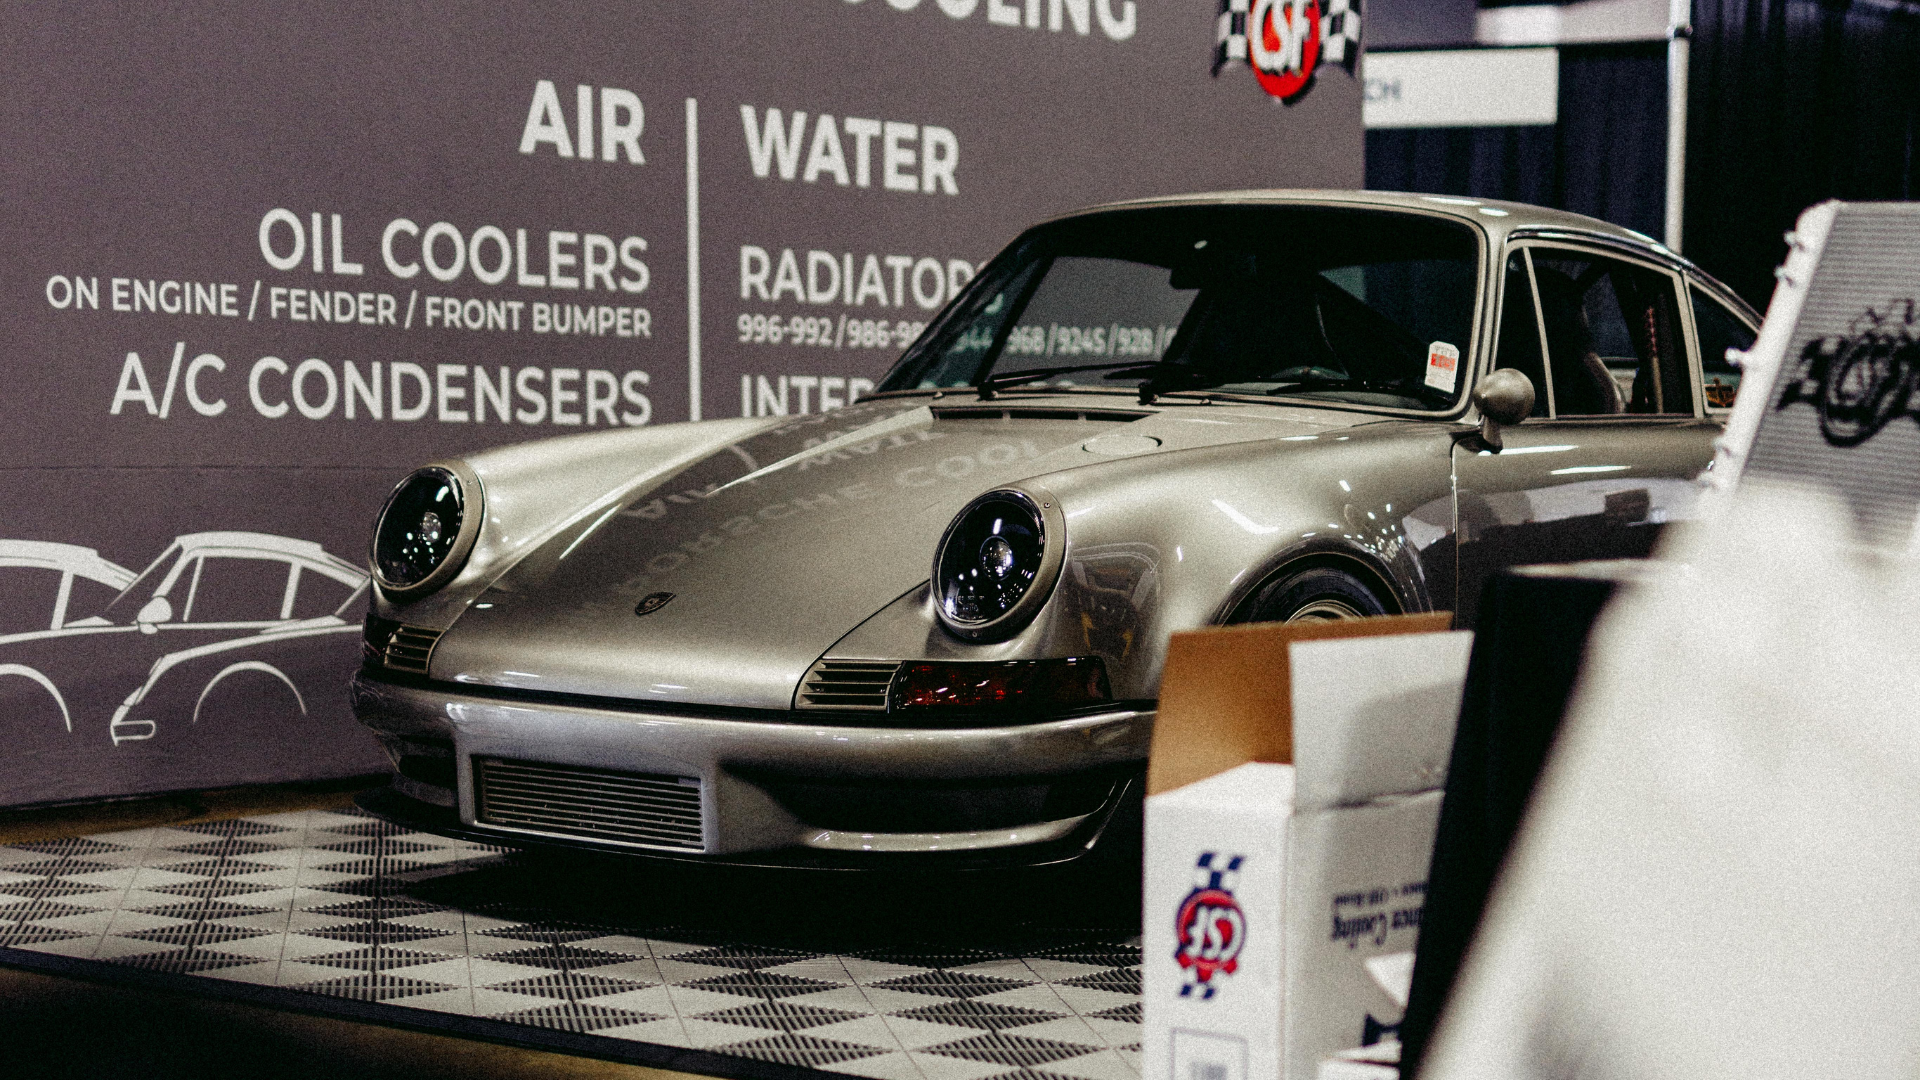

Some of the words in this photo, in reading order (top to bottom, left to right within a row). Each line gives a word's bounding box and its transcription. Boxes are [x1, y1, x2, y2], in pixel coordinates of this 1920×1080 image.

[519, 80, 646, 164] AIR
[740, 105, 958, 195] WATER
[259, 208, 364, 275] OIL
[378, 218, 650, 293] COOLERS
[740, 246, 988, 309] RADIATOR
[46, 275, 99, 309] ON
[111, 278, 239, 316] ENGINE
[270, 287, 397, 325] FENDER
[425, 297, 525, 331] FRONT
[532, 303, 652, 337] BUMPER
[110, 341, 227, 419] A/C
[248, 354, 653, 427] CONDENSERS
[1187, 906, 1245, 960] CSF
